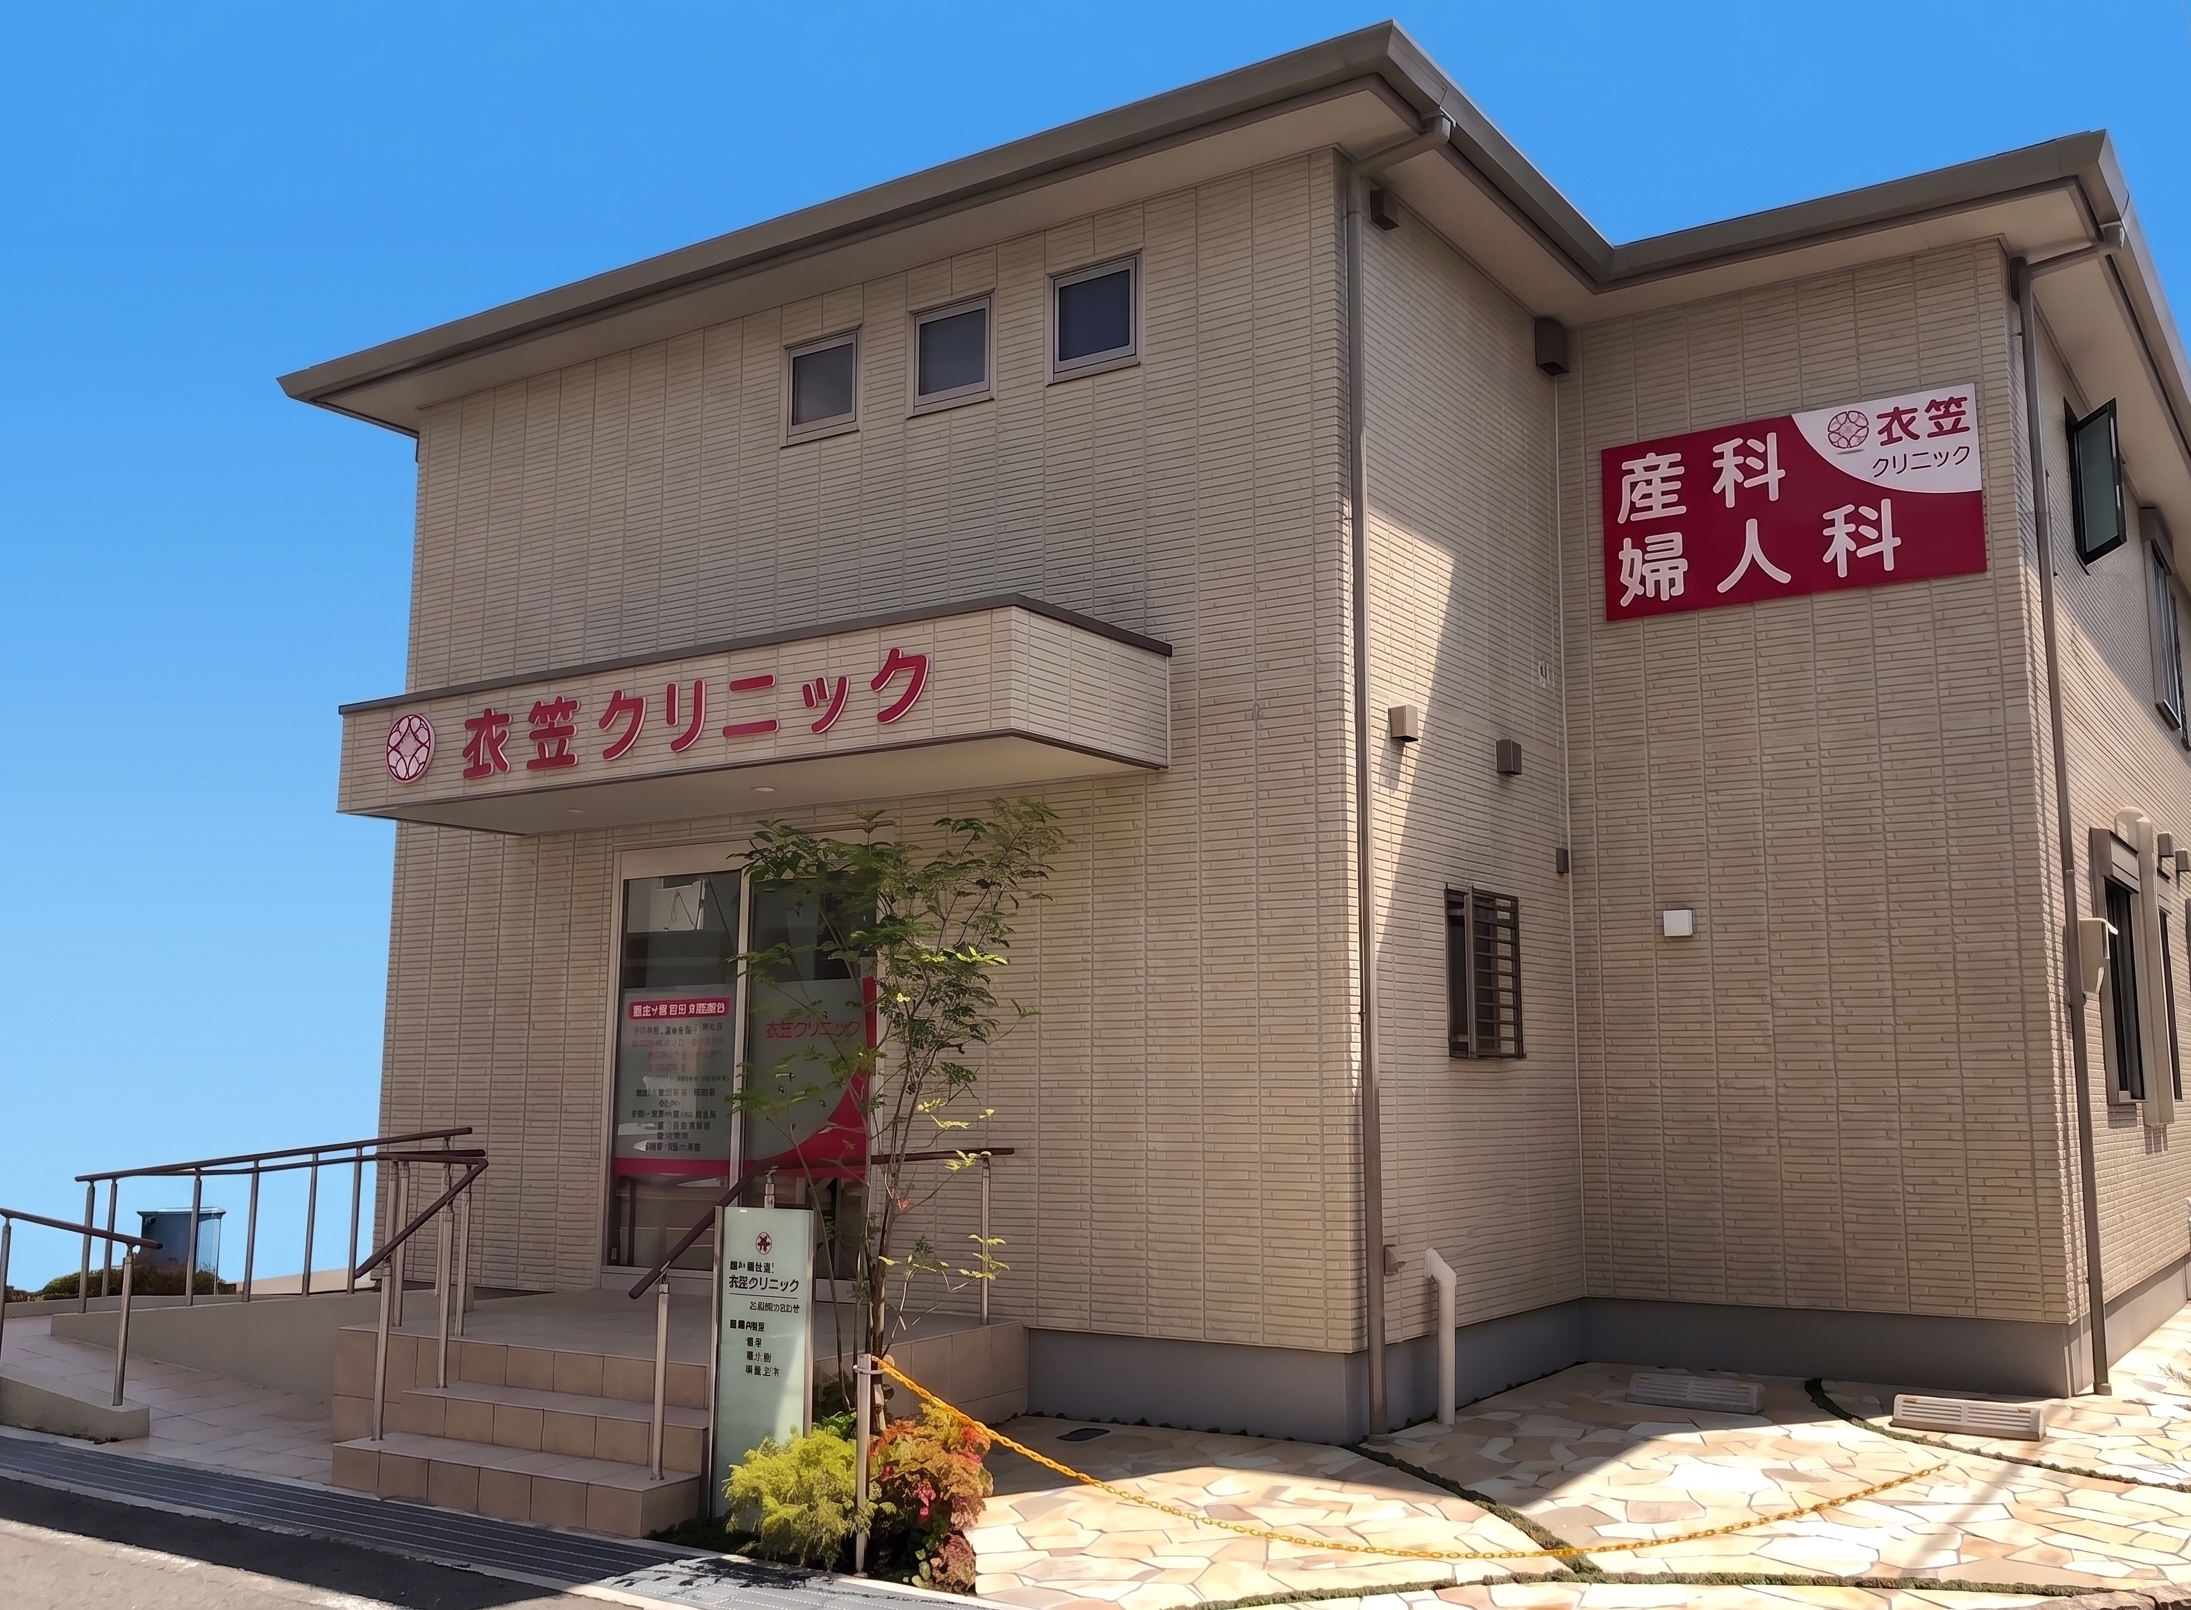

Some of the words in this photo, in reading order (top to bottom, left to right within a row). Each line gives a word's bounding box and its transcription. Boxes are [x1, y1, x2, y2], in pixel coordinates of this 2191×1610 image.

[1872, 445, 1971, 478] クリニック
[1876, 396, 1971, 448] 衣笠
[1617, 431, 1786, 525] 産科
[1618, 498, 1902, 608] 婦人科
[461, 647, 930, 780] 衣笠クリニック
